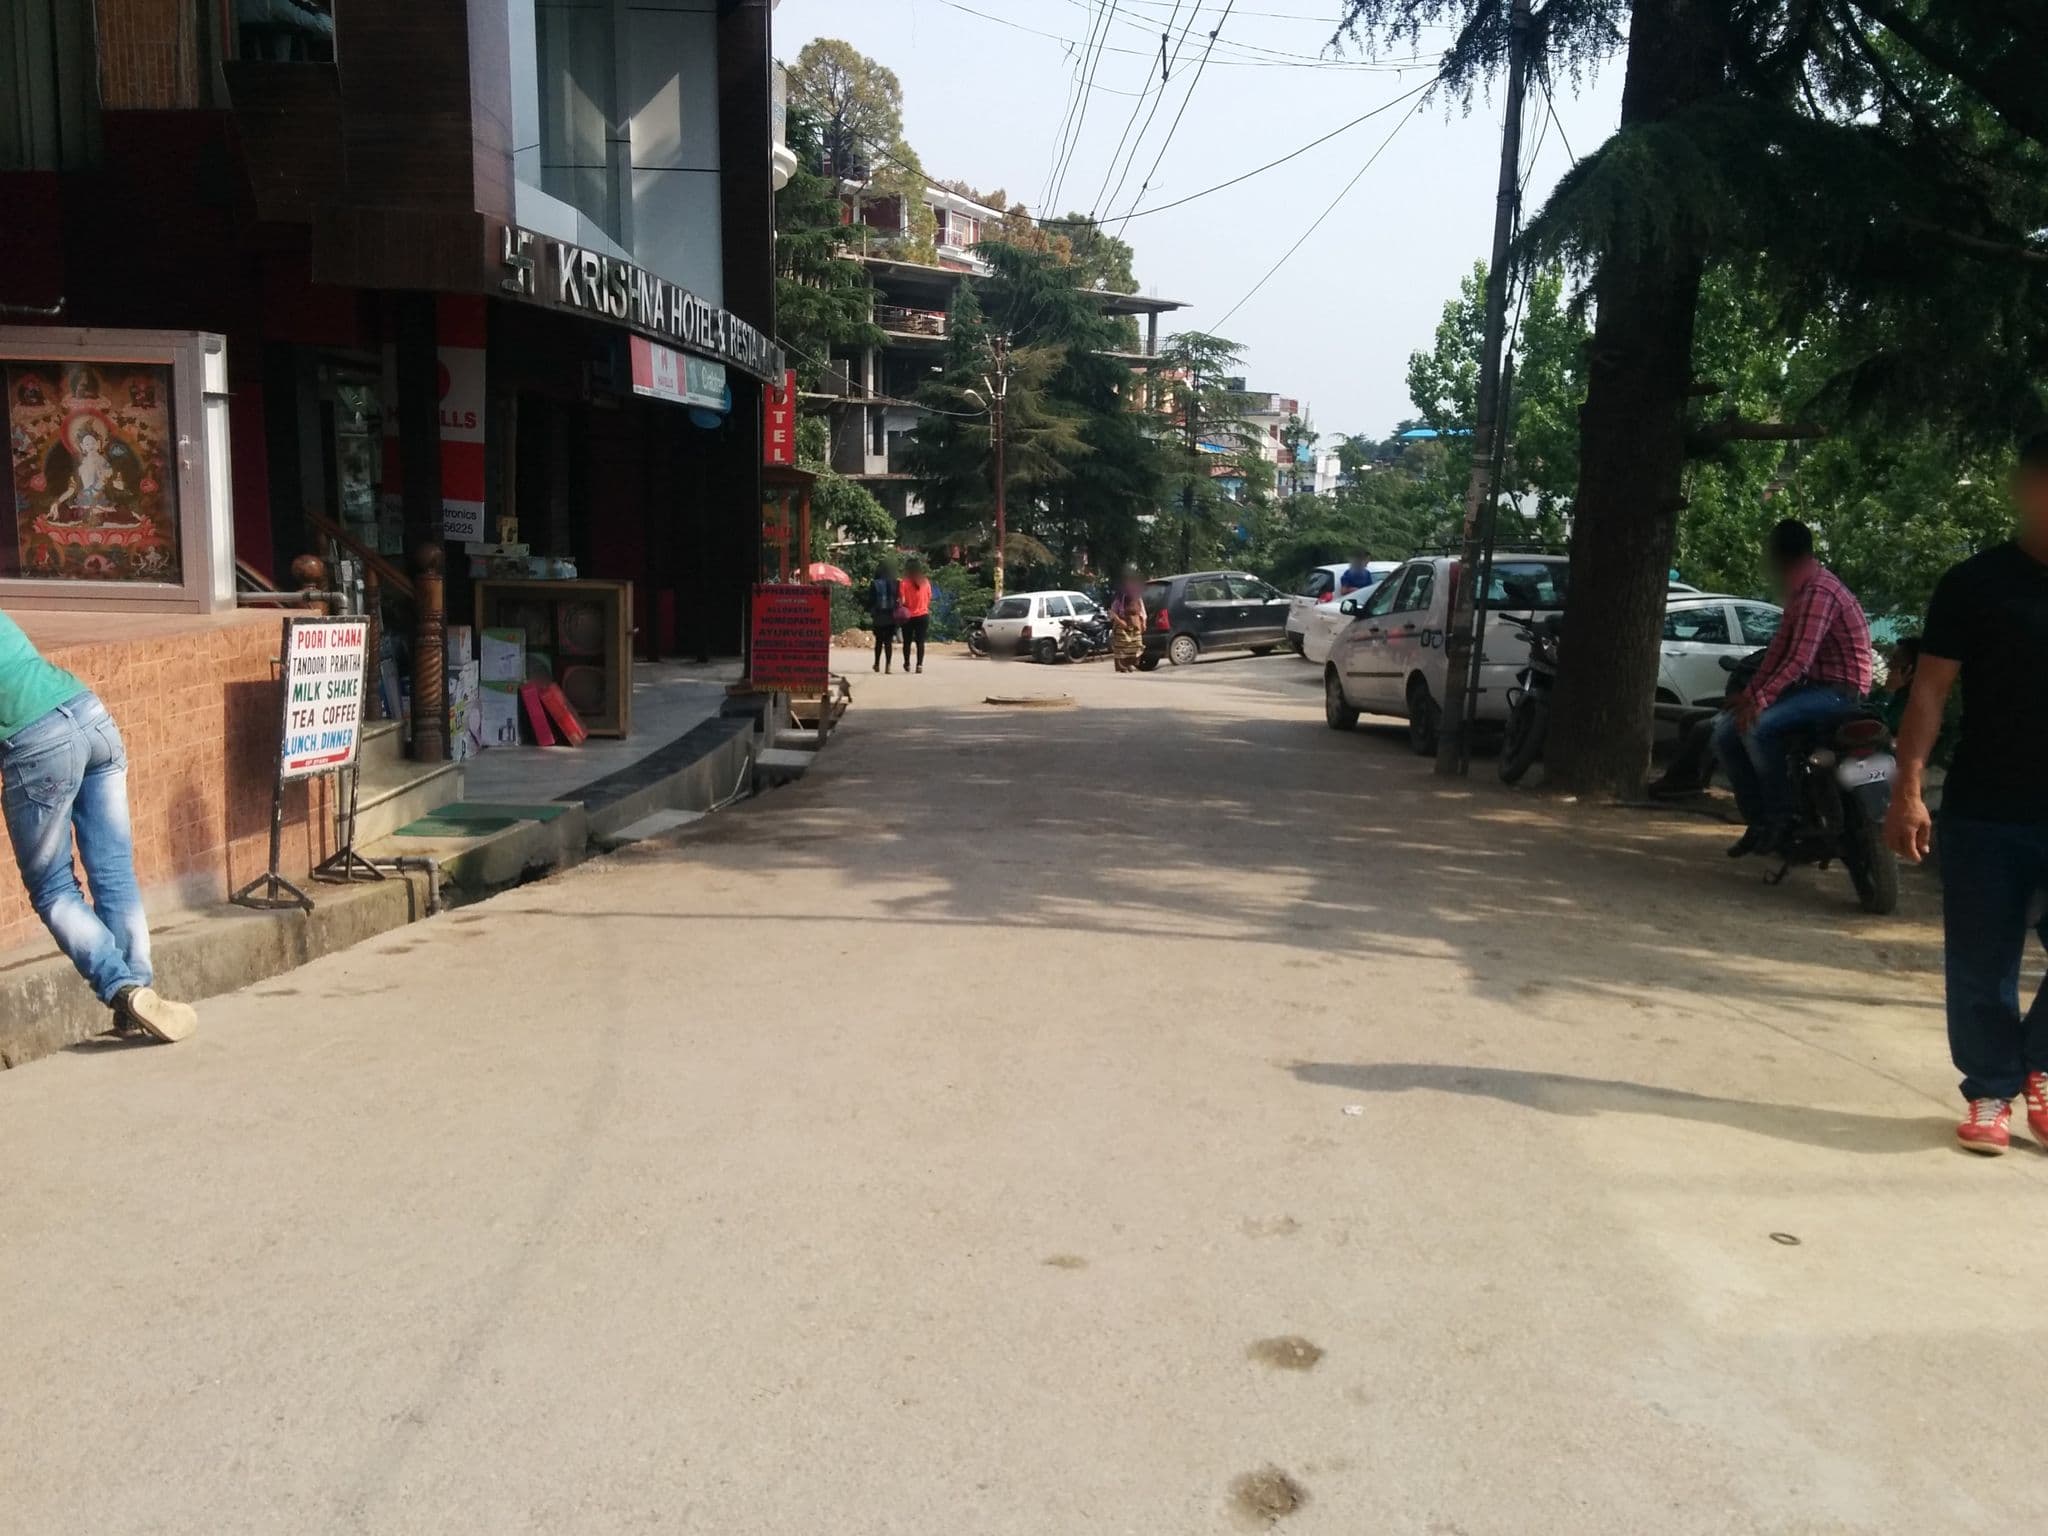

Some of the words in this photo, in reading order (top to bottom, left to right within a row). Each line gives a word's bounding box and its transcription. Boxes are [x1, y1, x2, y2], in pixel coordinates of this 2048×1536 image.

[558, 244, 664, 330] KRISHNA
[671, 285, 714, 349] HOTEL
[717, 309, 726, 353] &
[771, 373, 789, 462] OTEL
[297, 630, 327, 650] POORI
[331, 628, 362, 647] CHANA
[758, 628, 825, 638] AYURVEDIC
[293, 656, 327, 676] TANDOORI
[330, 653, 361, 674] PRANTHA
[292, 681, 321, 703] MILK
[327, 678, 358, 699] SHAKE
[292, 708, 315, 730] TEA
[322, 703, 356, 725] COFFEE
[321, 728, 353, 750] DINNER
